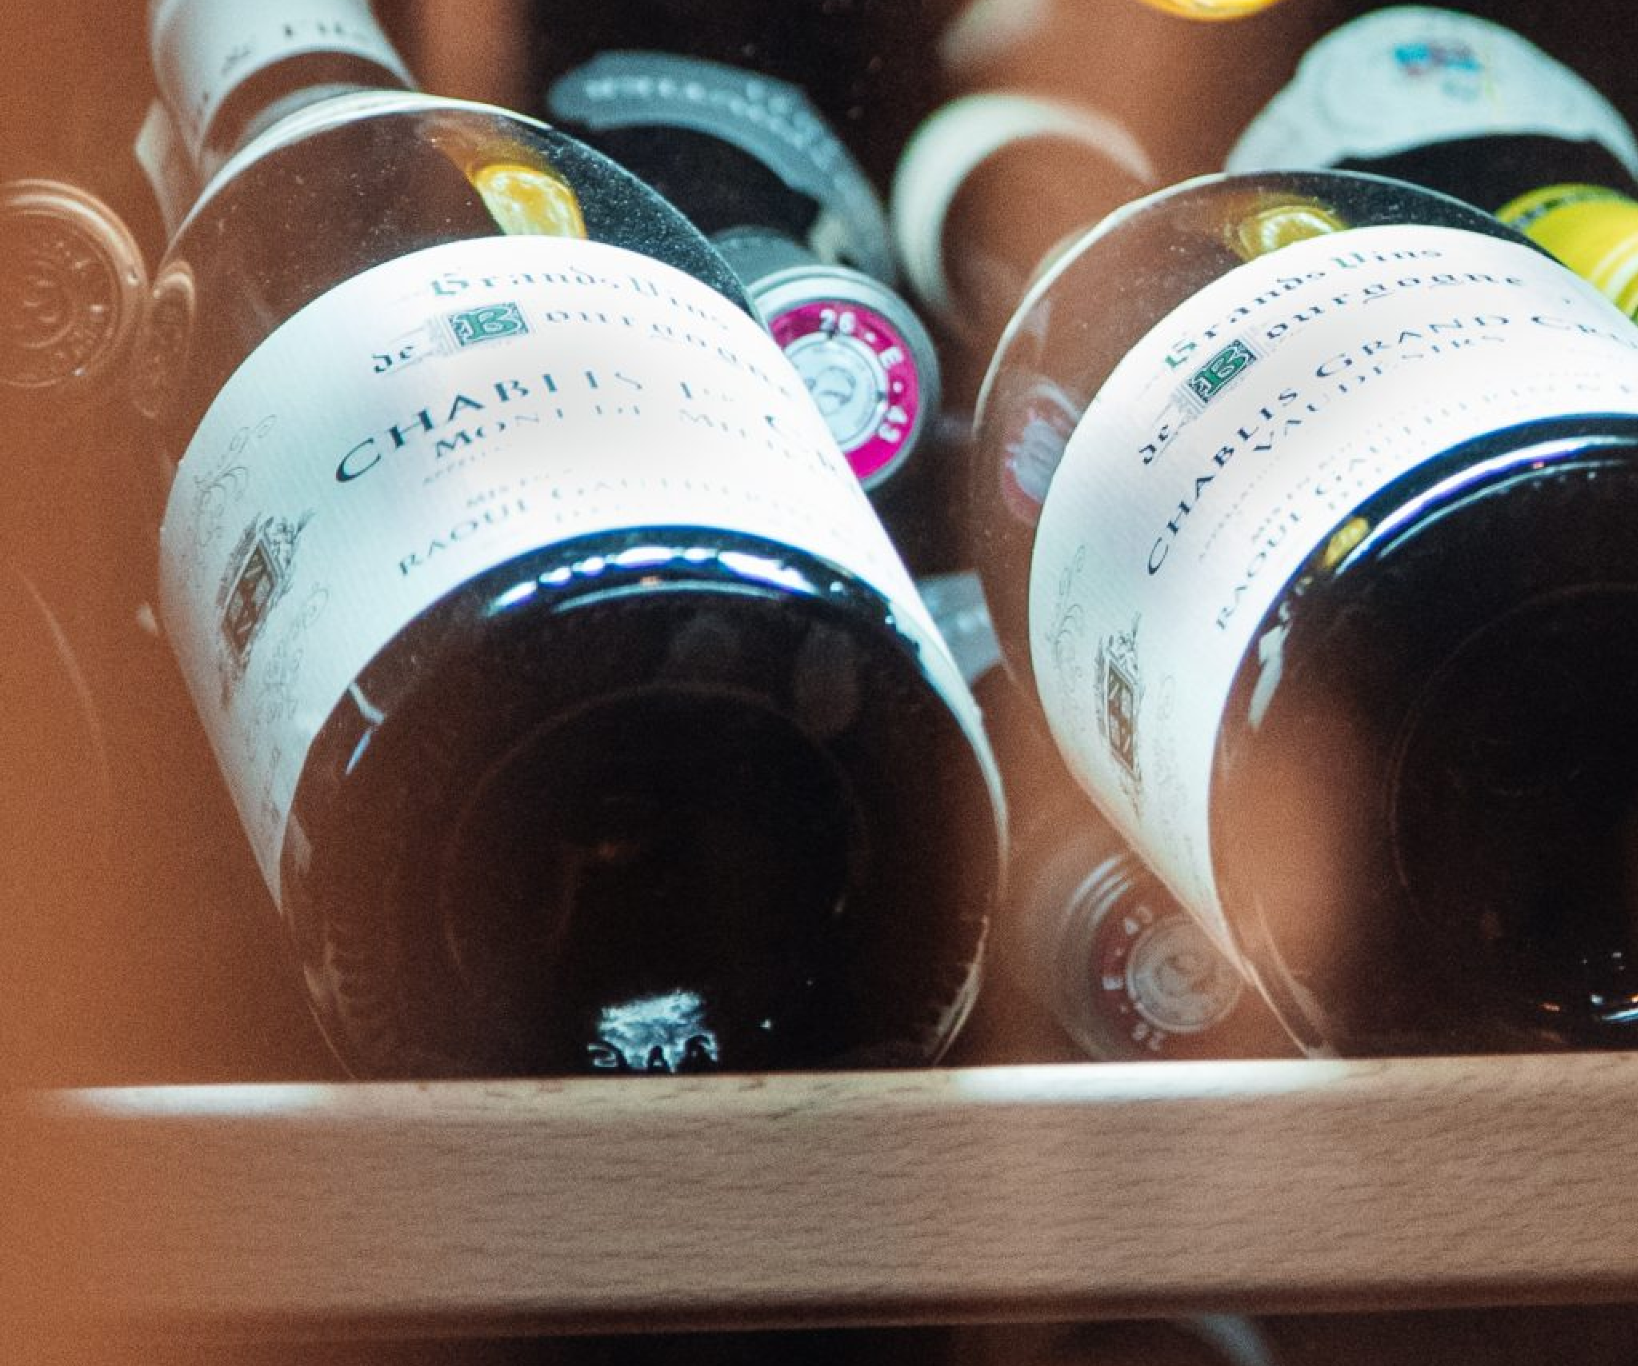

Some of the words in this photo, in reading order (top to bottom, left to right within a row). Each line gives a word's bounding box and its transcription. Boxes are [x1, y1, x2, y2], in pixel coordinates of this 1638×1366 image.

[1165, 269, 1326, 371] Grands
[334, 369, 645, 483] CHABLIS
[1145, 386, 1299, 577] CHABLIS
[1314, 313, 1511, 380] GRAND
